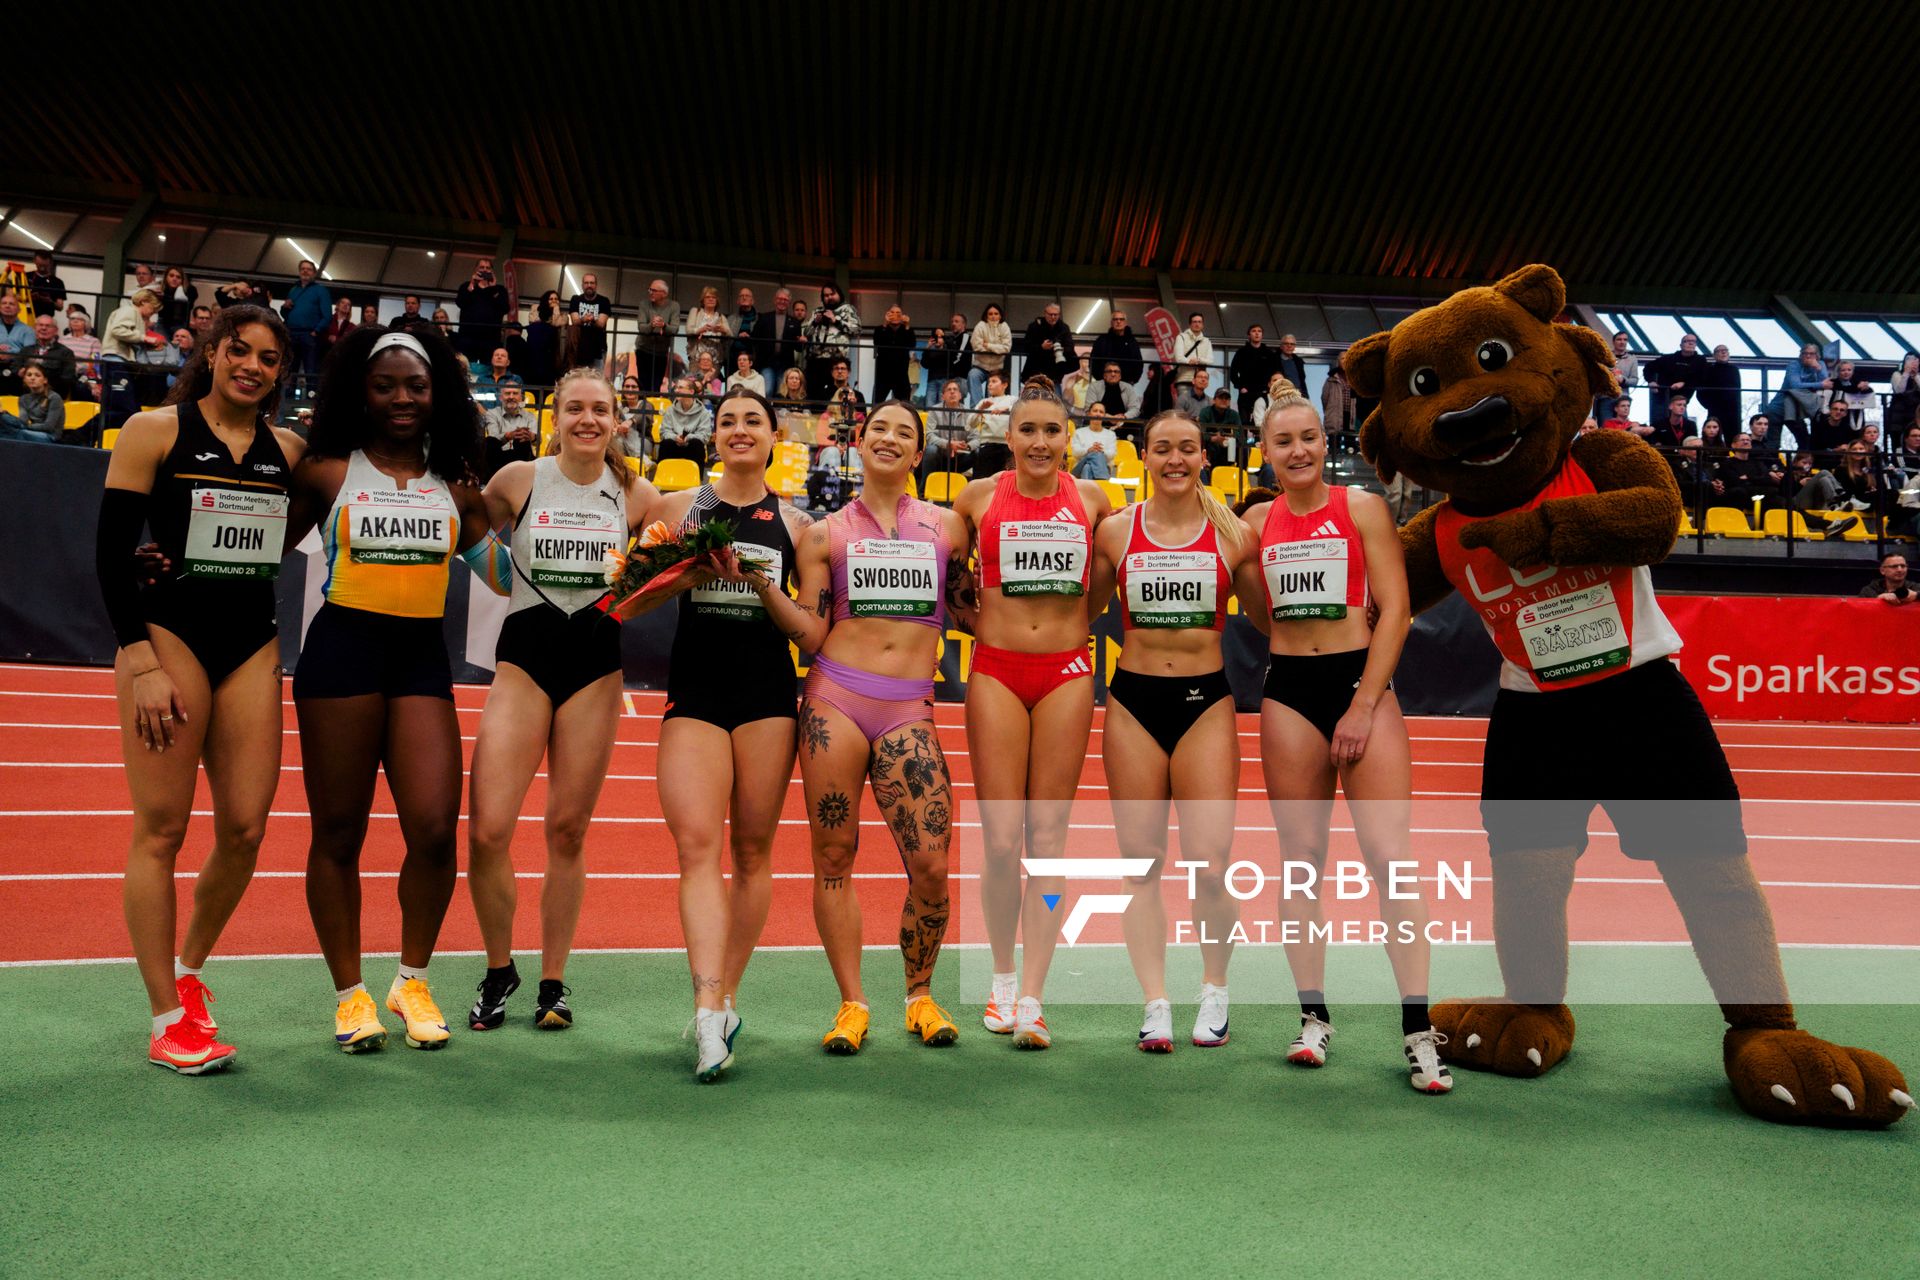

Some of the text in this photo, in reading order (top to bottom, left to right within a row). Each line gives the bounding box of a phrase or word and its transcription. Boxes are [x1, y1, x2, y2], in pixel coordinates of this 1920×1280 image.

[219, 493, 270, 506] Indoor Meeting
[373, 490, 426, 500] Indoor Meeting
[373, 496, 410, 504] Dortmund
[219, 502, 254, 512] Dortmund
[576, 512, 601, 520] Meeting
[553, 518, 586, 526] Dortmund
[360, 516, 442, 540] AKANDE
[1021, 523, 1069, 533] Indoor Meeting
[212, 525, 265, 550] JOHN
[1021, 530, 1054, 538] Dortmund
[736, 545, 763, 554] Meeting
[889, 542, 915, 550] Meeting
[1279, 543, 1326, 553] Indoor Meeting
[359, 551, 421, 560] DORTMUND 26
[1168, 554, 1196, 562] Meeting
[1279, 551, 1310, 559] Dortmund
[1015, 551, 1074, 571] HAASE
[193, 564, 256, 575] DORTMUND 26
[538, 574, 594, 584] DORTMUND 26
[853, 567, 933, 589] SWOBODA
[1280, 571, 1326, 595] JUNK
[1008, 584, 1051, 593] DORTMUND
[1141, 577, 1202, 602] BÜRGI
[1536, 592, 1589, 612] Indoor Meeting
[697, 606, 752, 616] DORTMUND 26
[856, 604, 902, 612] DORTMUND
[903, 604, 914, 612] 26
[1538, 604, 1574, 620] Dortmund
[1274, 608, 1321, 619] DORTMUND 26
[1136, 616, 1191, 624] DORTMUND 26
[1530, 617, 1618, 657] BÄRND
[1542, 658, 1605, 679] DORTMUND 26
[1706, 654, 1920, 703] Sparkass
[823, 876, 844, 891] 777
